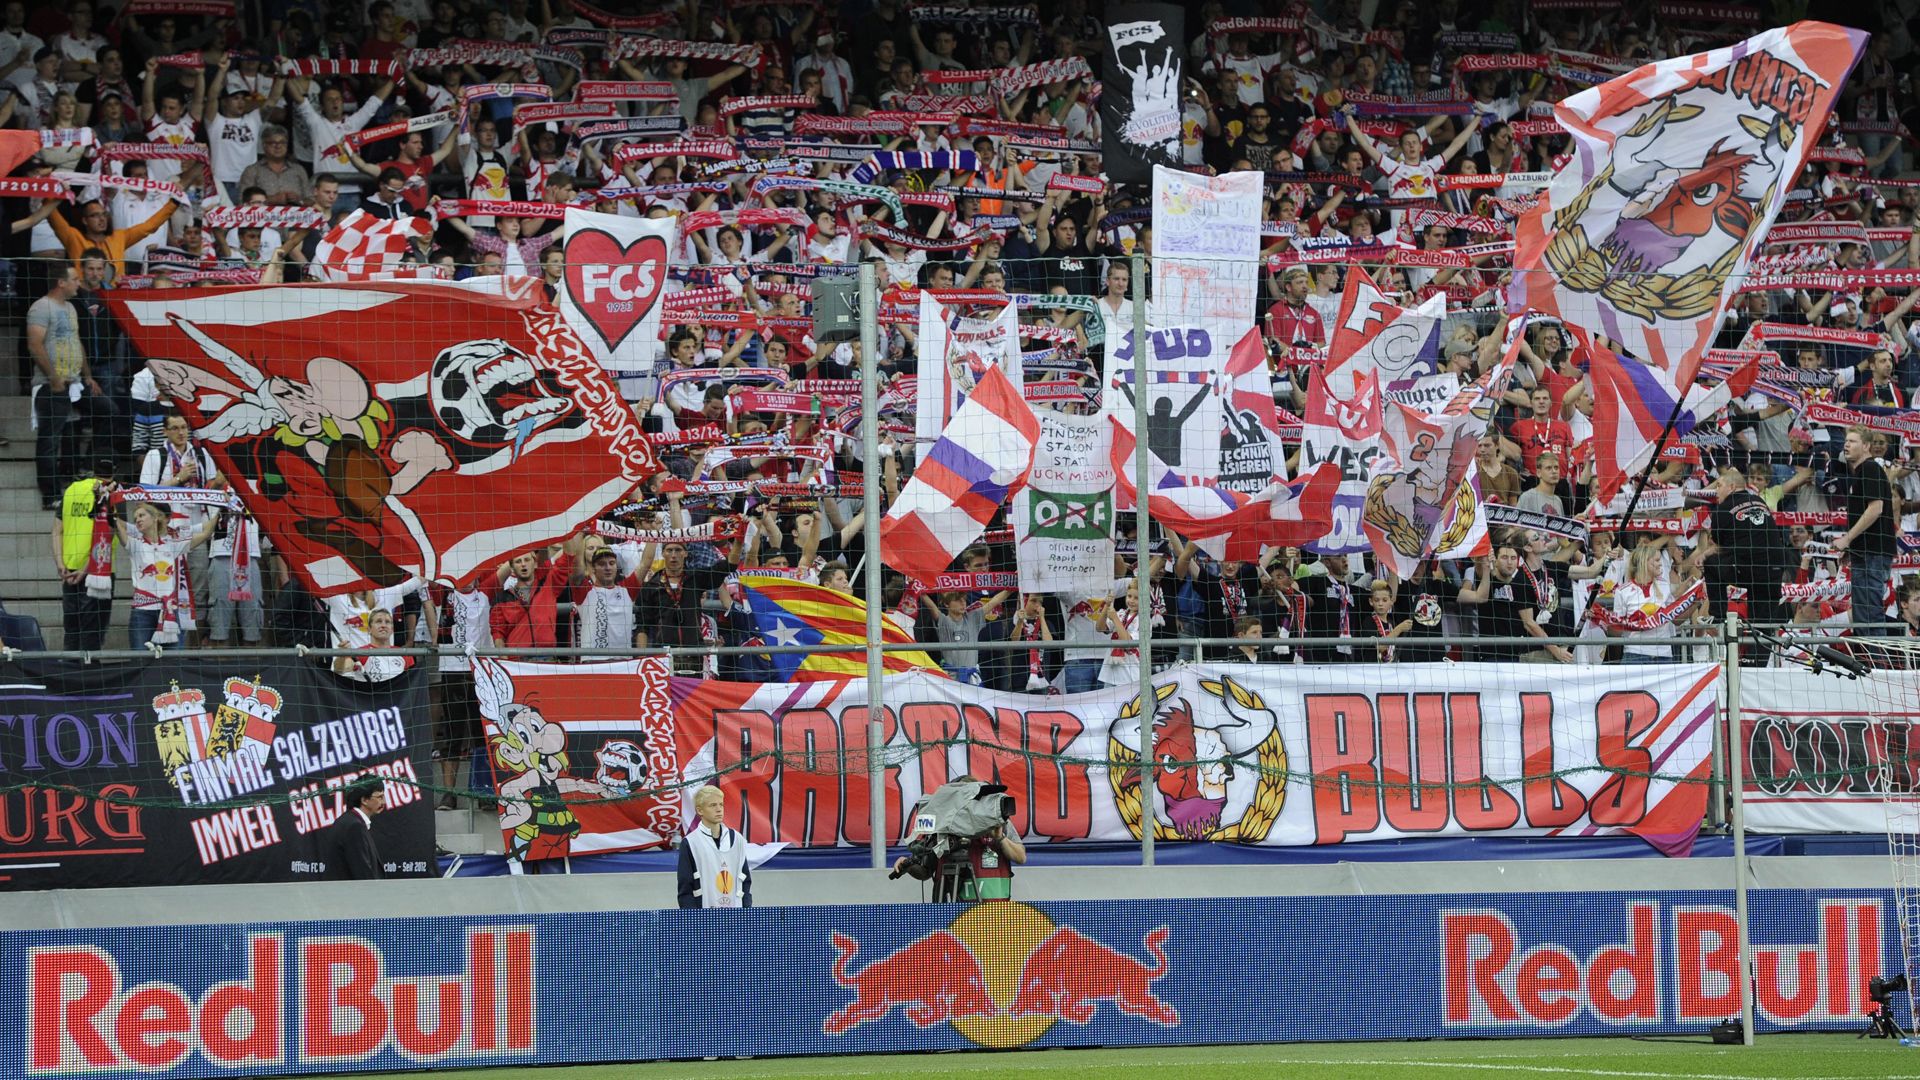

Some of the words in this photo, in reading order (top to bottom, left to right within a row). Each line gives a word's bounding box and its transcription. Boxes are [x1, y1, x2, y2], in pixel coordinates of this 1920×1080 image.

[1658, 5, 1705, 17] UROPA
[1711, 8, 1760, 20] LEAGUE
[1213, 19, 1234, 33] Red
[1236, 17, 1258, 28] Bull
[1115, 25, 1154, 40] FCS
[1463, 56, 1497, 68] Red
[1499, 56, 1538, 68] Bulls
[1003, 74, 1026, 88] Red
[1027, 68, 1049, 83] Bull
[599, 84, 623, 95] Bull
[723, 96, 745, 111] Red
[747, 95, 772, 106] Bull
[537, 105, 561, 117] Bull
[578, 123, 603, 136] Red
[604, 120, 628, 133] Bull
[823, 118, 850, 130] Bull
[1009, 134, 1038, 147] Red
[805, 146, 829, 157] Bull
[100, 174, 137, 187] Red
[1450, 173, 1503, 185] LEBENSLANG
[1508, 174, 1549, 184] SALZBURG
[478, 201, 514, 213] Red
[517, 203, 565, 214] Bulls
[209, 210, 234, 223] Red
[236, 210, 261, 223] Bull
[1298, 250, 1323, 261] Red
[1324, 248, 1346, 259] Bull
[1398, 250, 1428, 264] Red
[1431, 253, 1466, 267] Bulls
[581, 259, 657, 303] FCS
[1742, 277, 1767, 288] Red
[1768, 275, 1793, 287] Bull
[1296, 347, 1319, 361] Red
[1774, 370, 1799, 382] Bull
[1813, 406, 1841, 420] Red
[1842, 410, 1872, 425] Bull
[650, 430, 682, 443] TOUR
[687, 423, 721, 440] 13/14
[1552, 444, 1562, 454] 93
[685, 482, 707, 492] 100%
[708, 482, 722, 492] RED
[723, 481, 743, 491] BULL
[122, 492, 148, 502] 100%
[150, 493, 168, 502] RED
[169, 493, 190, 503] BULL
[1034, 499, 1105, 529] ORF
[1048, 553, 1076, 562] Rapid
[941, 573, 971, 588] Bull
[1789, 585, 1812, 598] Bull
[174, 742, 275, 807] EINMAL
[273, 705, 406, 783] SALZBURG!
[1304, 690, 1660, 847] BULLS
[191, 802, 282, 867] IMMER
[1440, 901, 1662, 1027] Red
[1672, 897, 1885, 1025] Bull
[25, 931, 285, 1075] Red
[298, 924, 538, 1065] Bull
